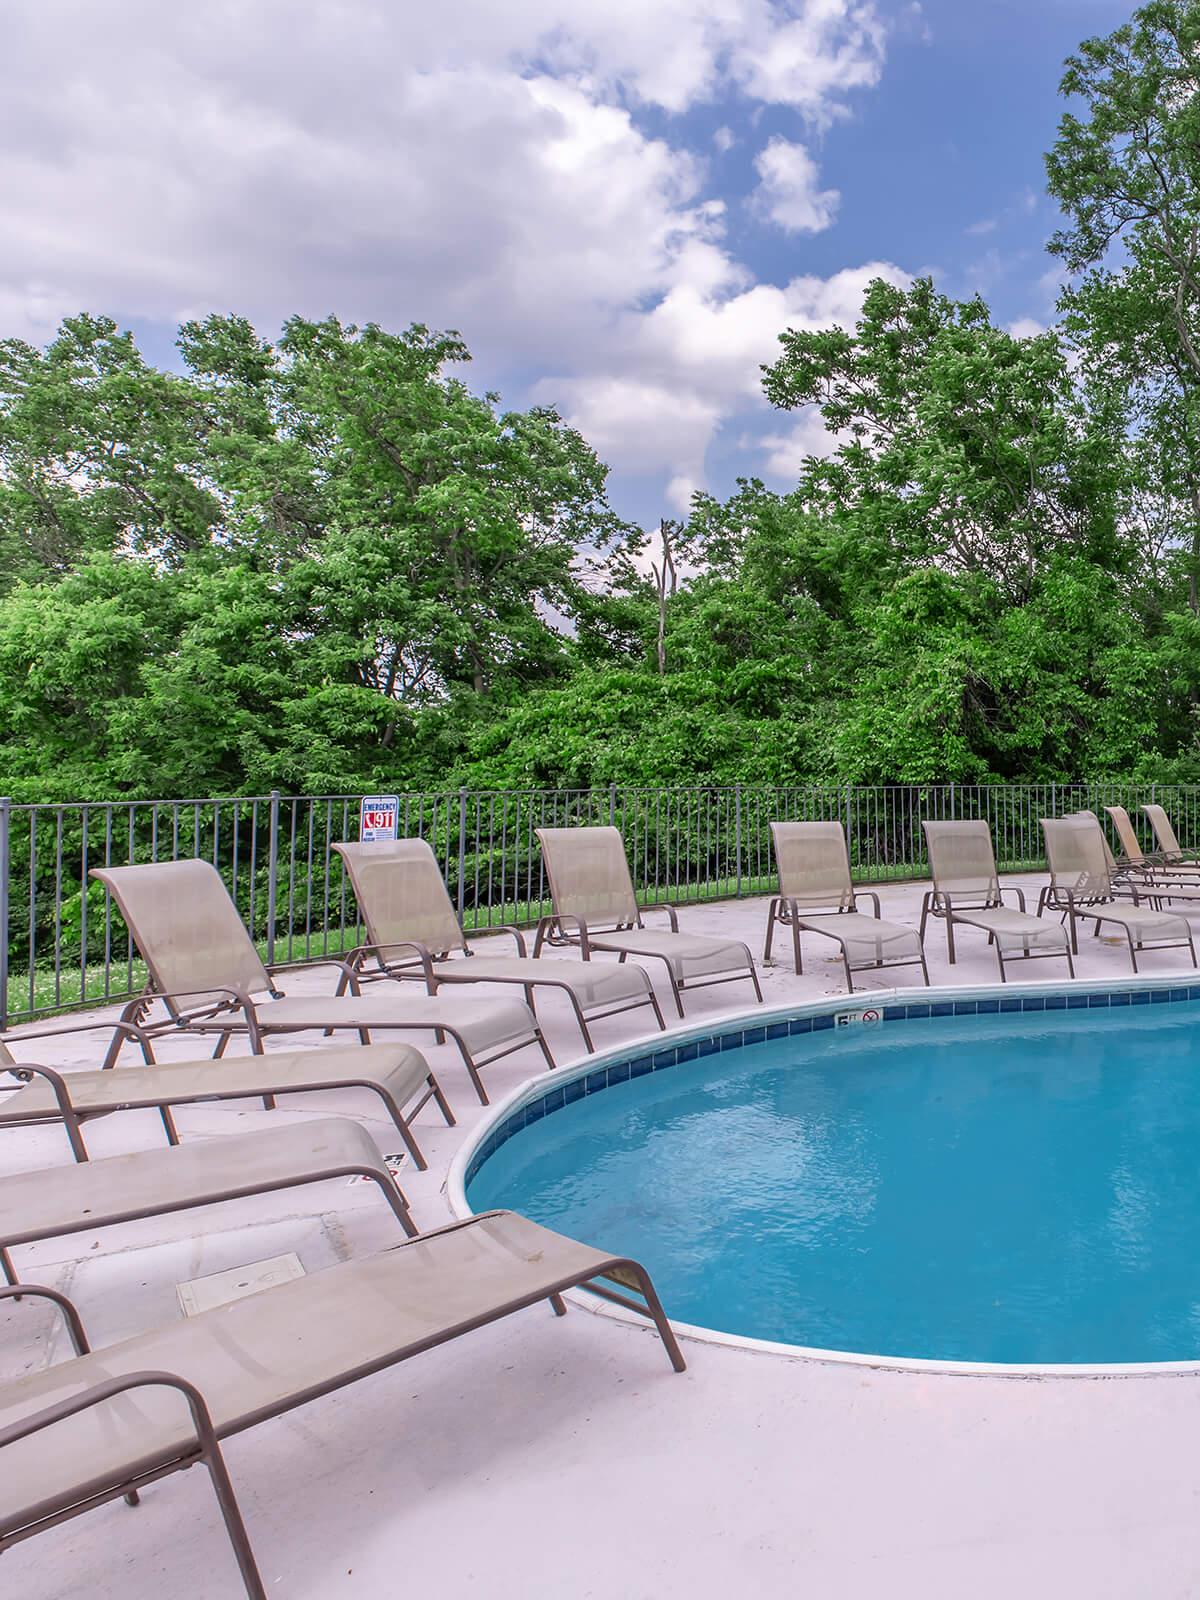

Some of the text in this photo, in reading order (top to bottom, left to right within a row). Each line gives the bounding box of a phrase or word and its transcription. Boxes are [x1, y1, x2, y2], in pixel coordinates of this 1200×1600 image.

[364, 803, 396, 811] EMERGENCY
[375, 812, 394, 828] 911
[837, 1015, 849, 1026] 5
